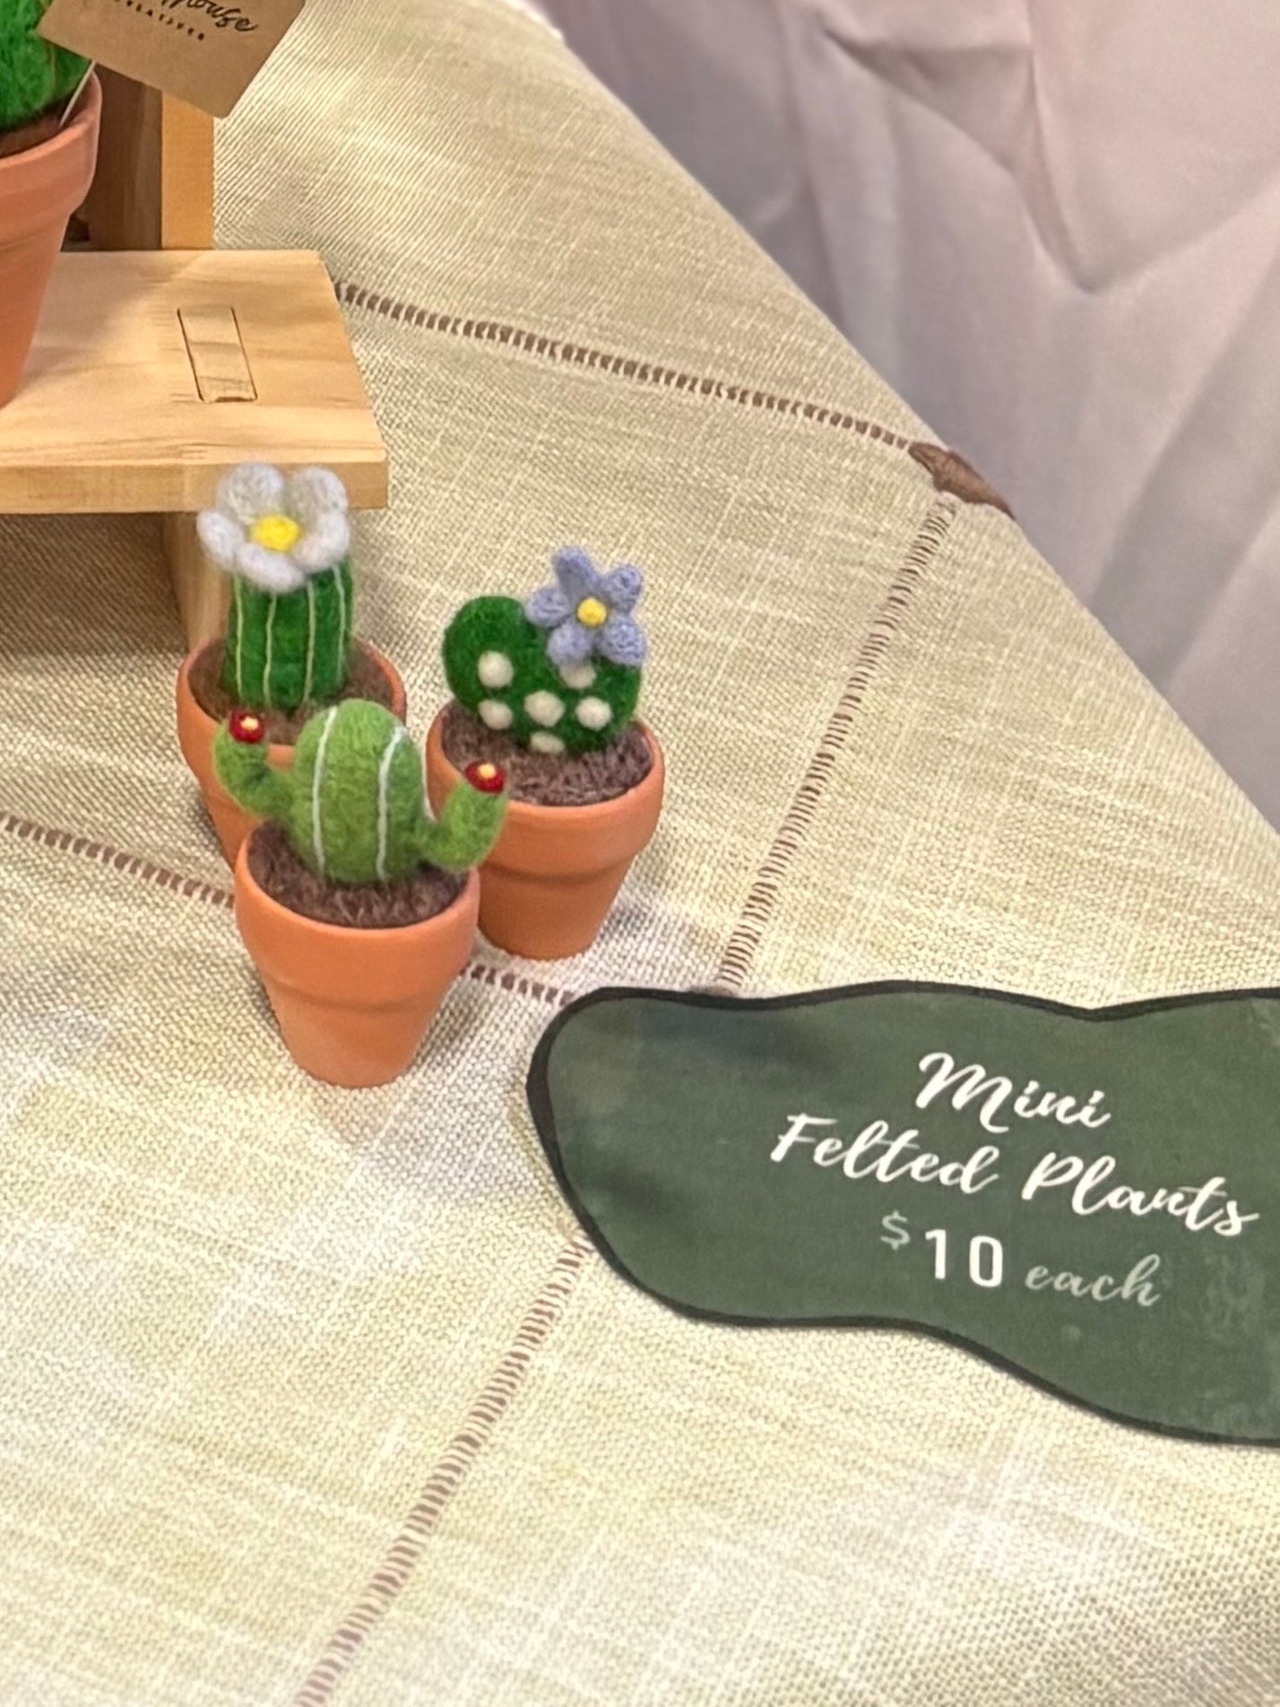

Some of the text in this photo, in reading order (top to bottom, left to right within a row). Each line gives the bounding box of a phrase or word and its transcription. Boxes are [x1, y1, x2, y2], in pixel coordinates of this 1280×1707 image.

[913, 1051, 1111, 1135] Mini
[769, 1112, 1261, 1238] Felted Plants
[1024, 1253, 1163, 1308] each
